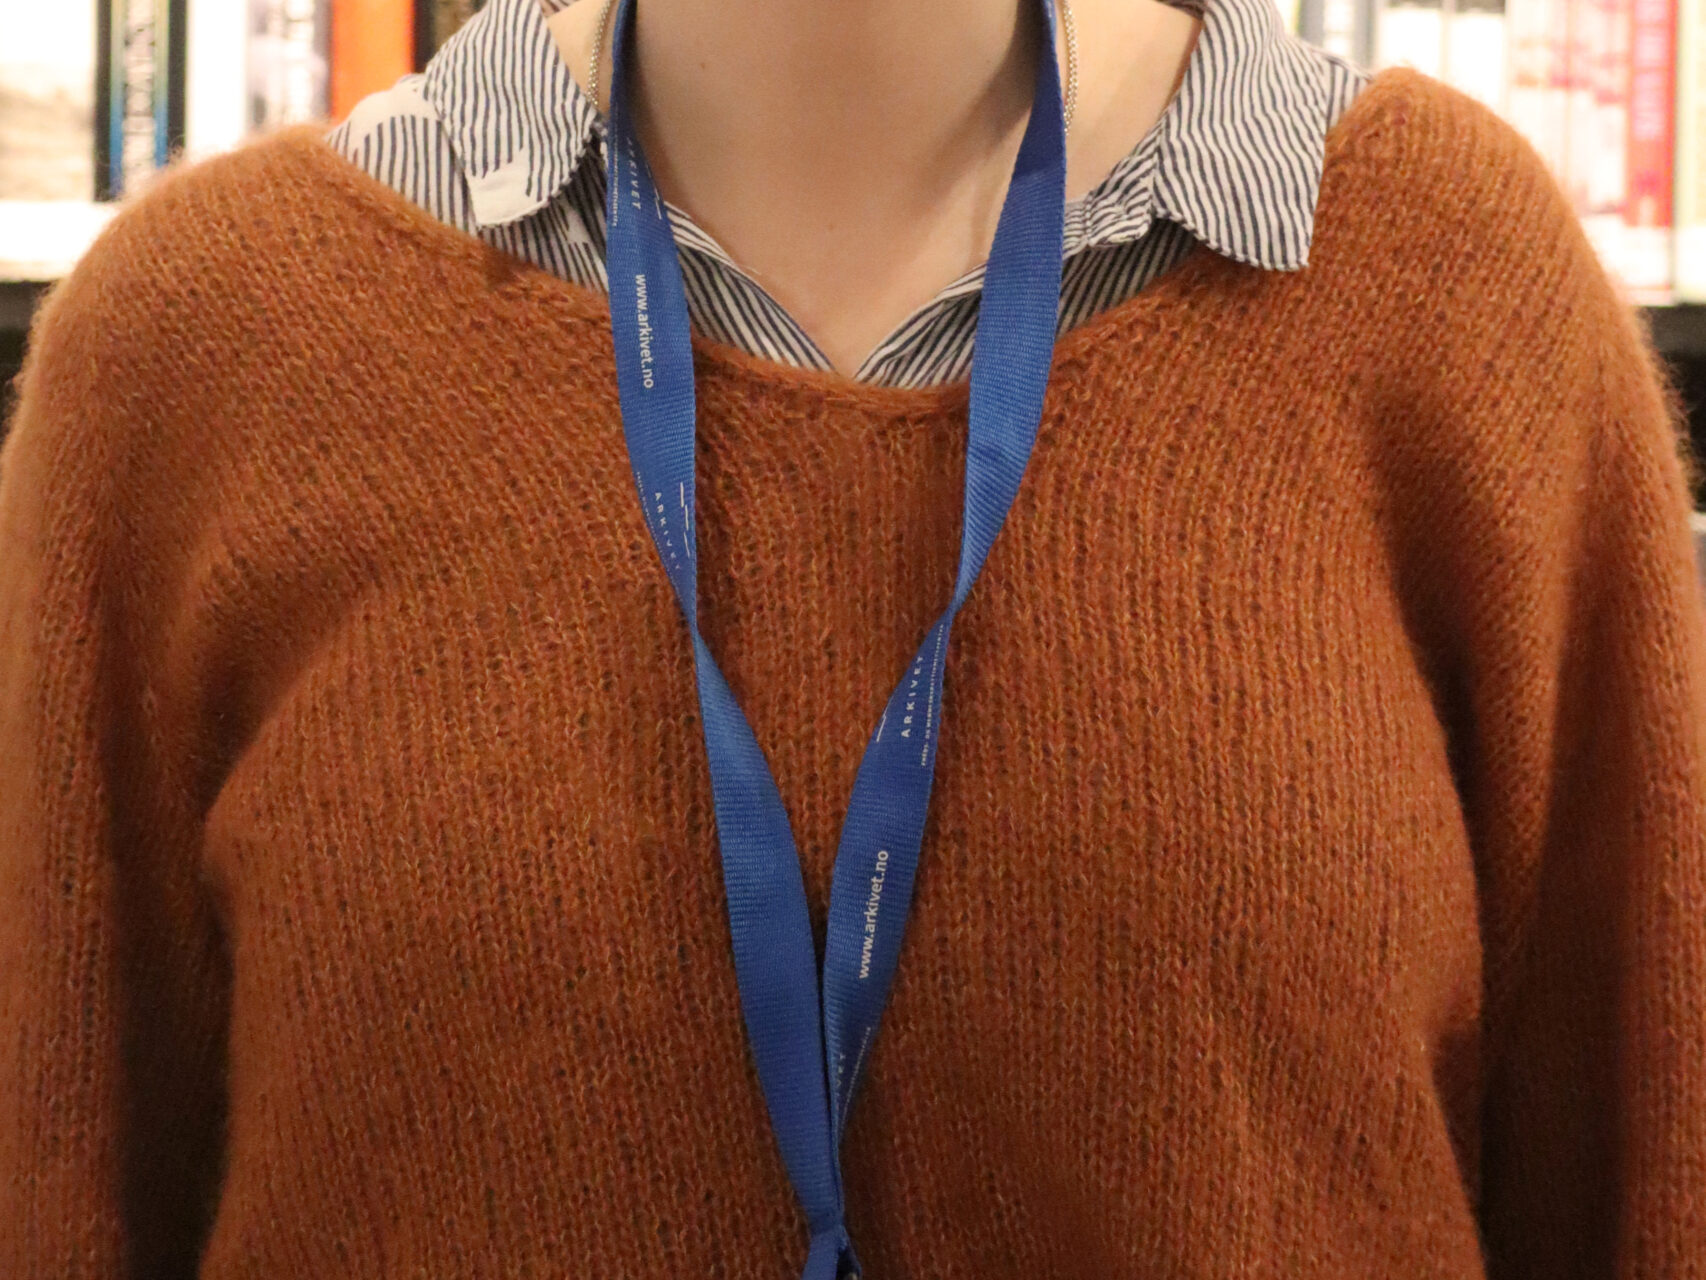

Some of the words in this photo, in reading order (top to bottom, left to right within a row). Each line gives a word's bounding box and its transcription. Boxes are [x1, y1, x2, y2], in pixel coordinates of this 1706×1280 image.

[634, 273, 655, 389] www.arkivet.no
[900, 655, 924, 738] ARKIVET
[859, 850, 889, 979] www.arkivet.no
